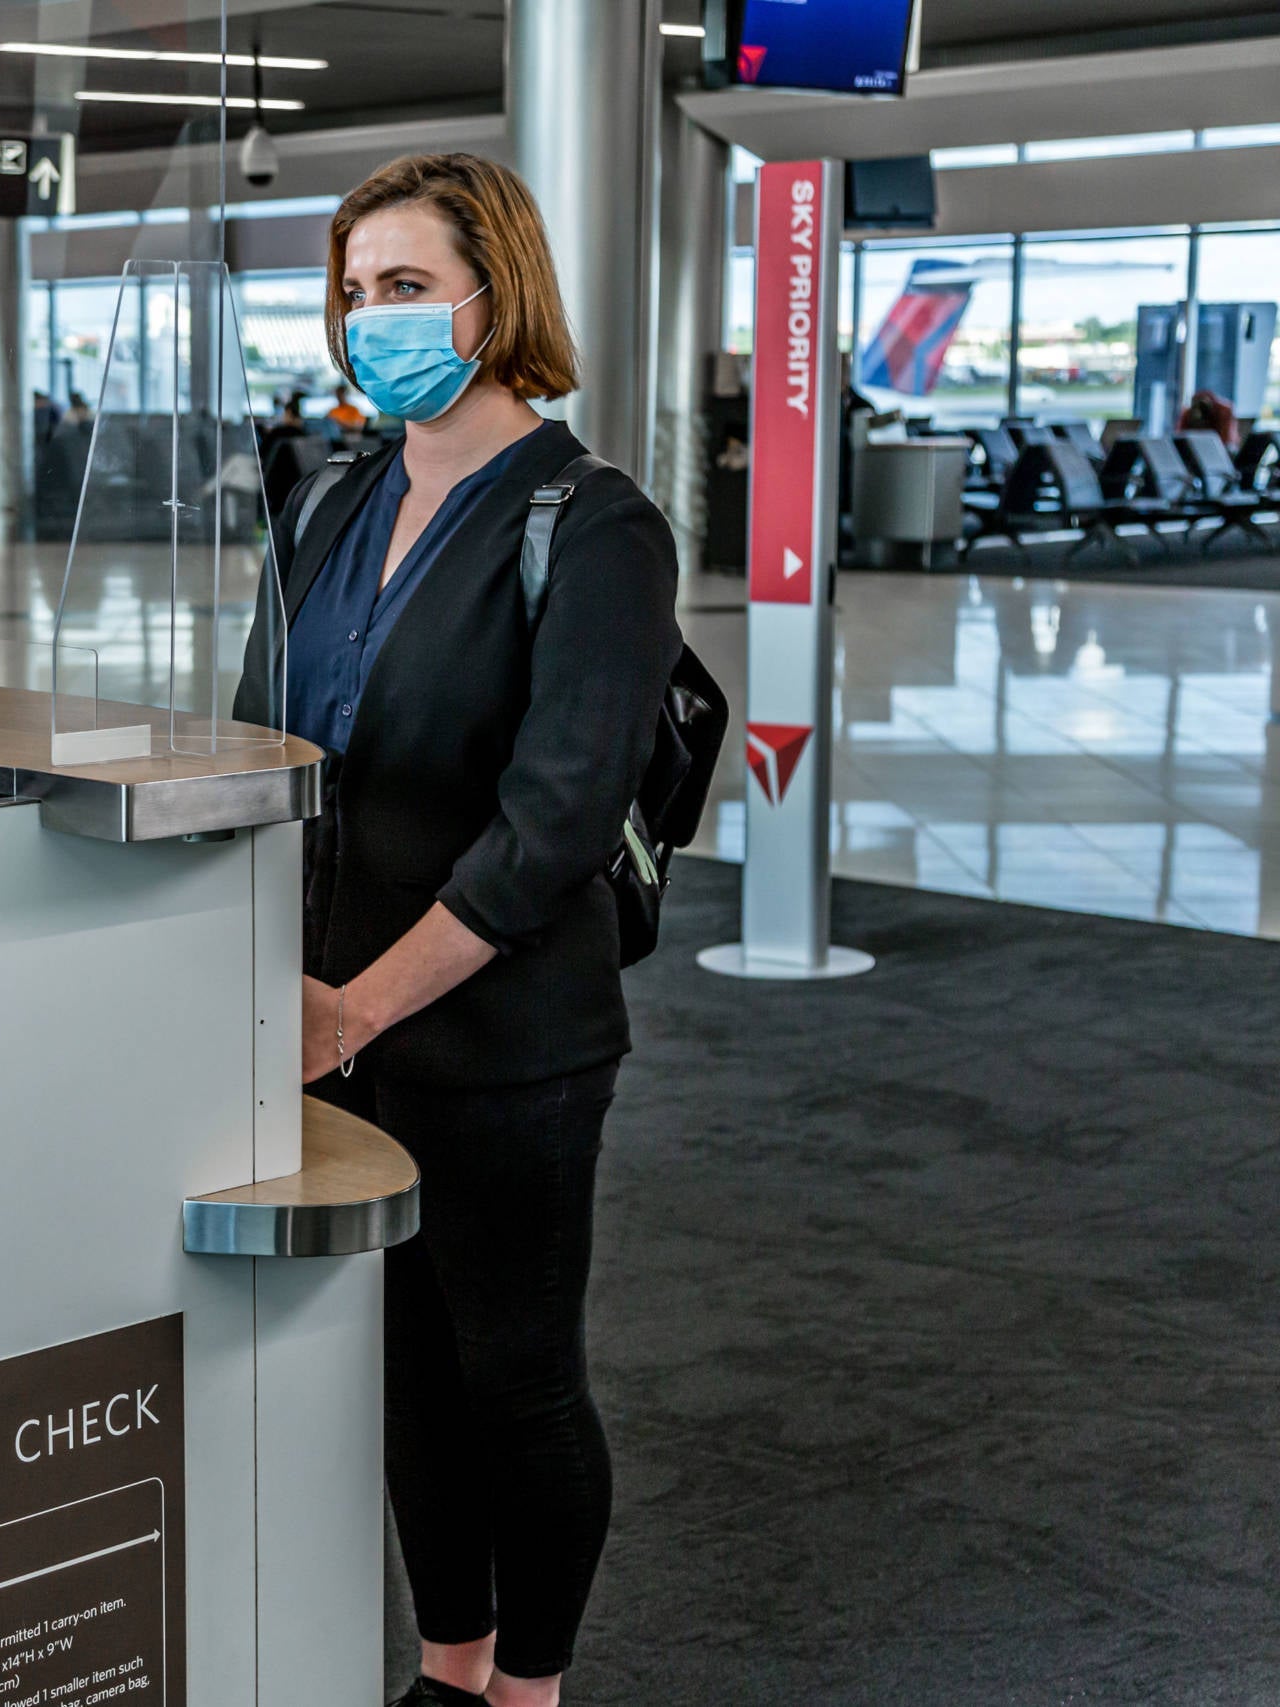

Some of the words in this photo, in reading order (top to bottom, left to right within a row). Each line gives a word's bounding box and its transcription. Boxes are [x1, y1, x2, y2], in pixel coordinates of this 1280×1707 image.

[791, 179, 814, 251] SKY
[786, 254, 812, 416] PRIORITY
[15, 1384, 160, 1462] CHECK
[43, 1620, 49, 1633] 1
[51, 1606, 98, 1630] carry-on
[100, 1598, 127, 1614] item.
[37, 1648, 45, 1661] x
[42, 1688, 48, 1701] 1
[50, 1676, 90, 1698] smaller
[92, 1667, 116, 1683] item
[119, 1656, 144, 1674] such
[86, 1683, 126, 1705] camera
[128, 1674, 150, 1690] bag,
